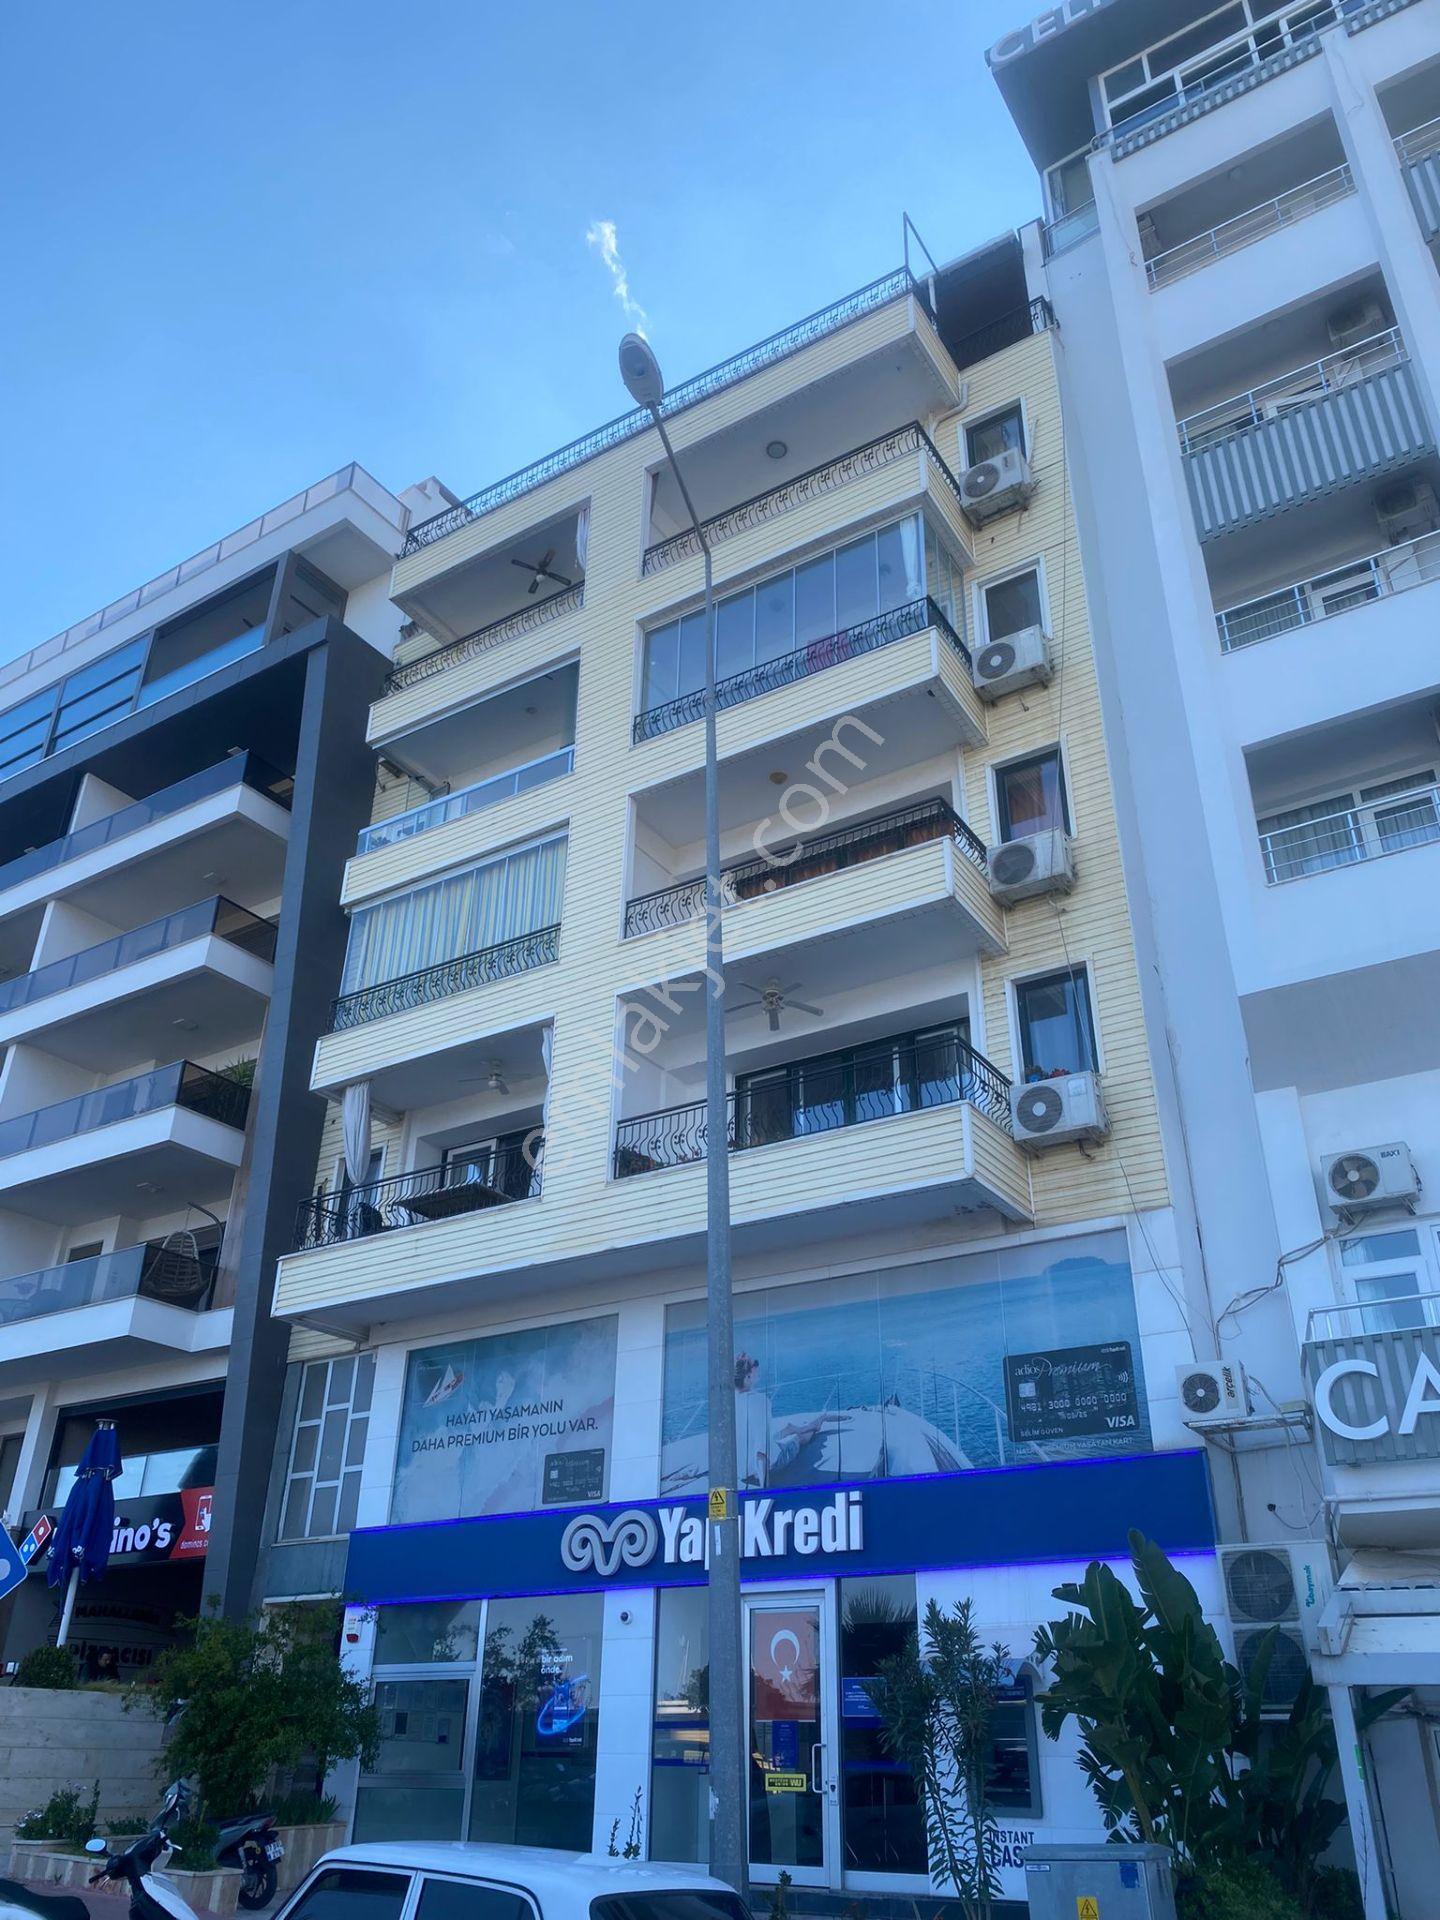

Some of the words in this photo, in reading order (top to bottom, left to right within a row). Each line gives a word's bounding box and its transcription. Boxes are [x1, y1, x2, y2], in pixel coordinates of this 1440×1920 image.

[1380, 1149, 1400, 1158] BAXI
[1075, 1396, 1097, 1406] 0000
[1103, 1392, 1127, 1404] 0000
[446, 1410, 488, 1428] HAYATI
[489, 1399, 564, 1422] YAŞAMANIN
[1105, 1415, 1136, 1428] VISA
[411, 1437, 446, 1453] DAHA
[447, 1430, 505, 1449] PREMIUM
[507, 1423, 530, 1442] BİR
[532, 1420, 567, 1438] YOLU
[568, 1417, 599, 1434] VAR.
[587, 1490, 601, 1498] VISA
[657, 1491, 863, 1571] YaKredi
[541, 1654, 552, 1664] bir
[989, 1830, 1034, 1845] INSTANT
[991, 1845, 1027, 1868] CAS
